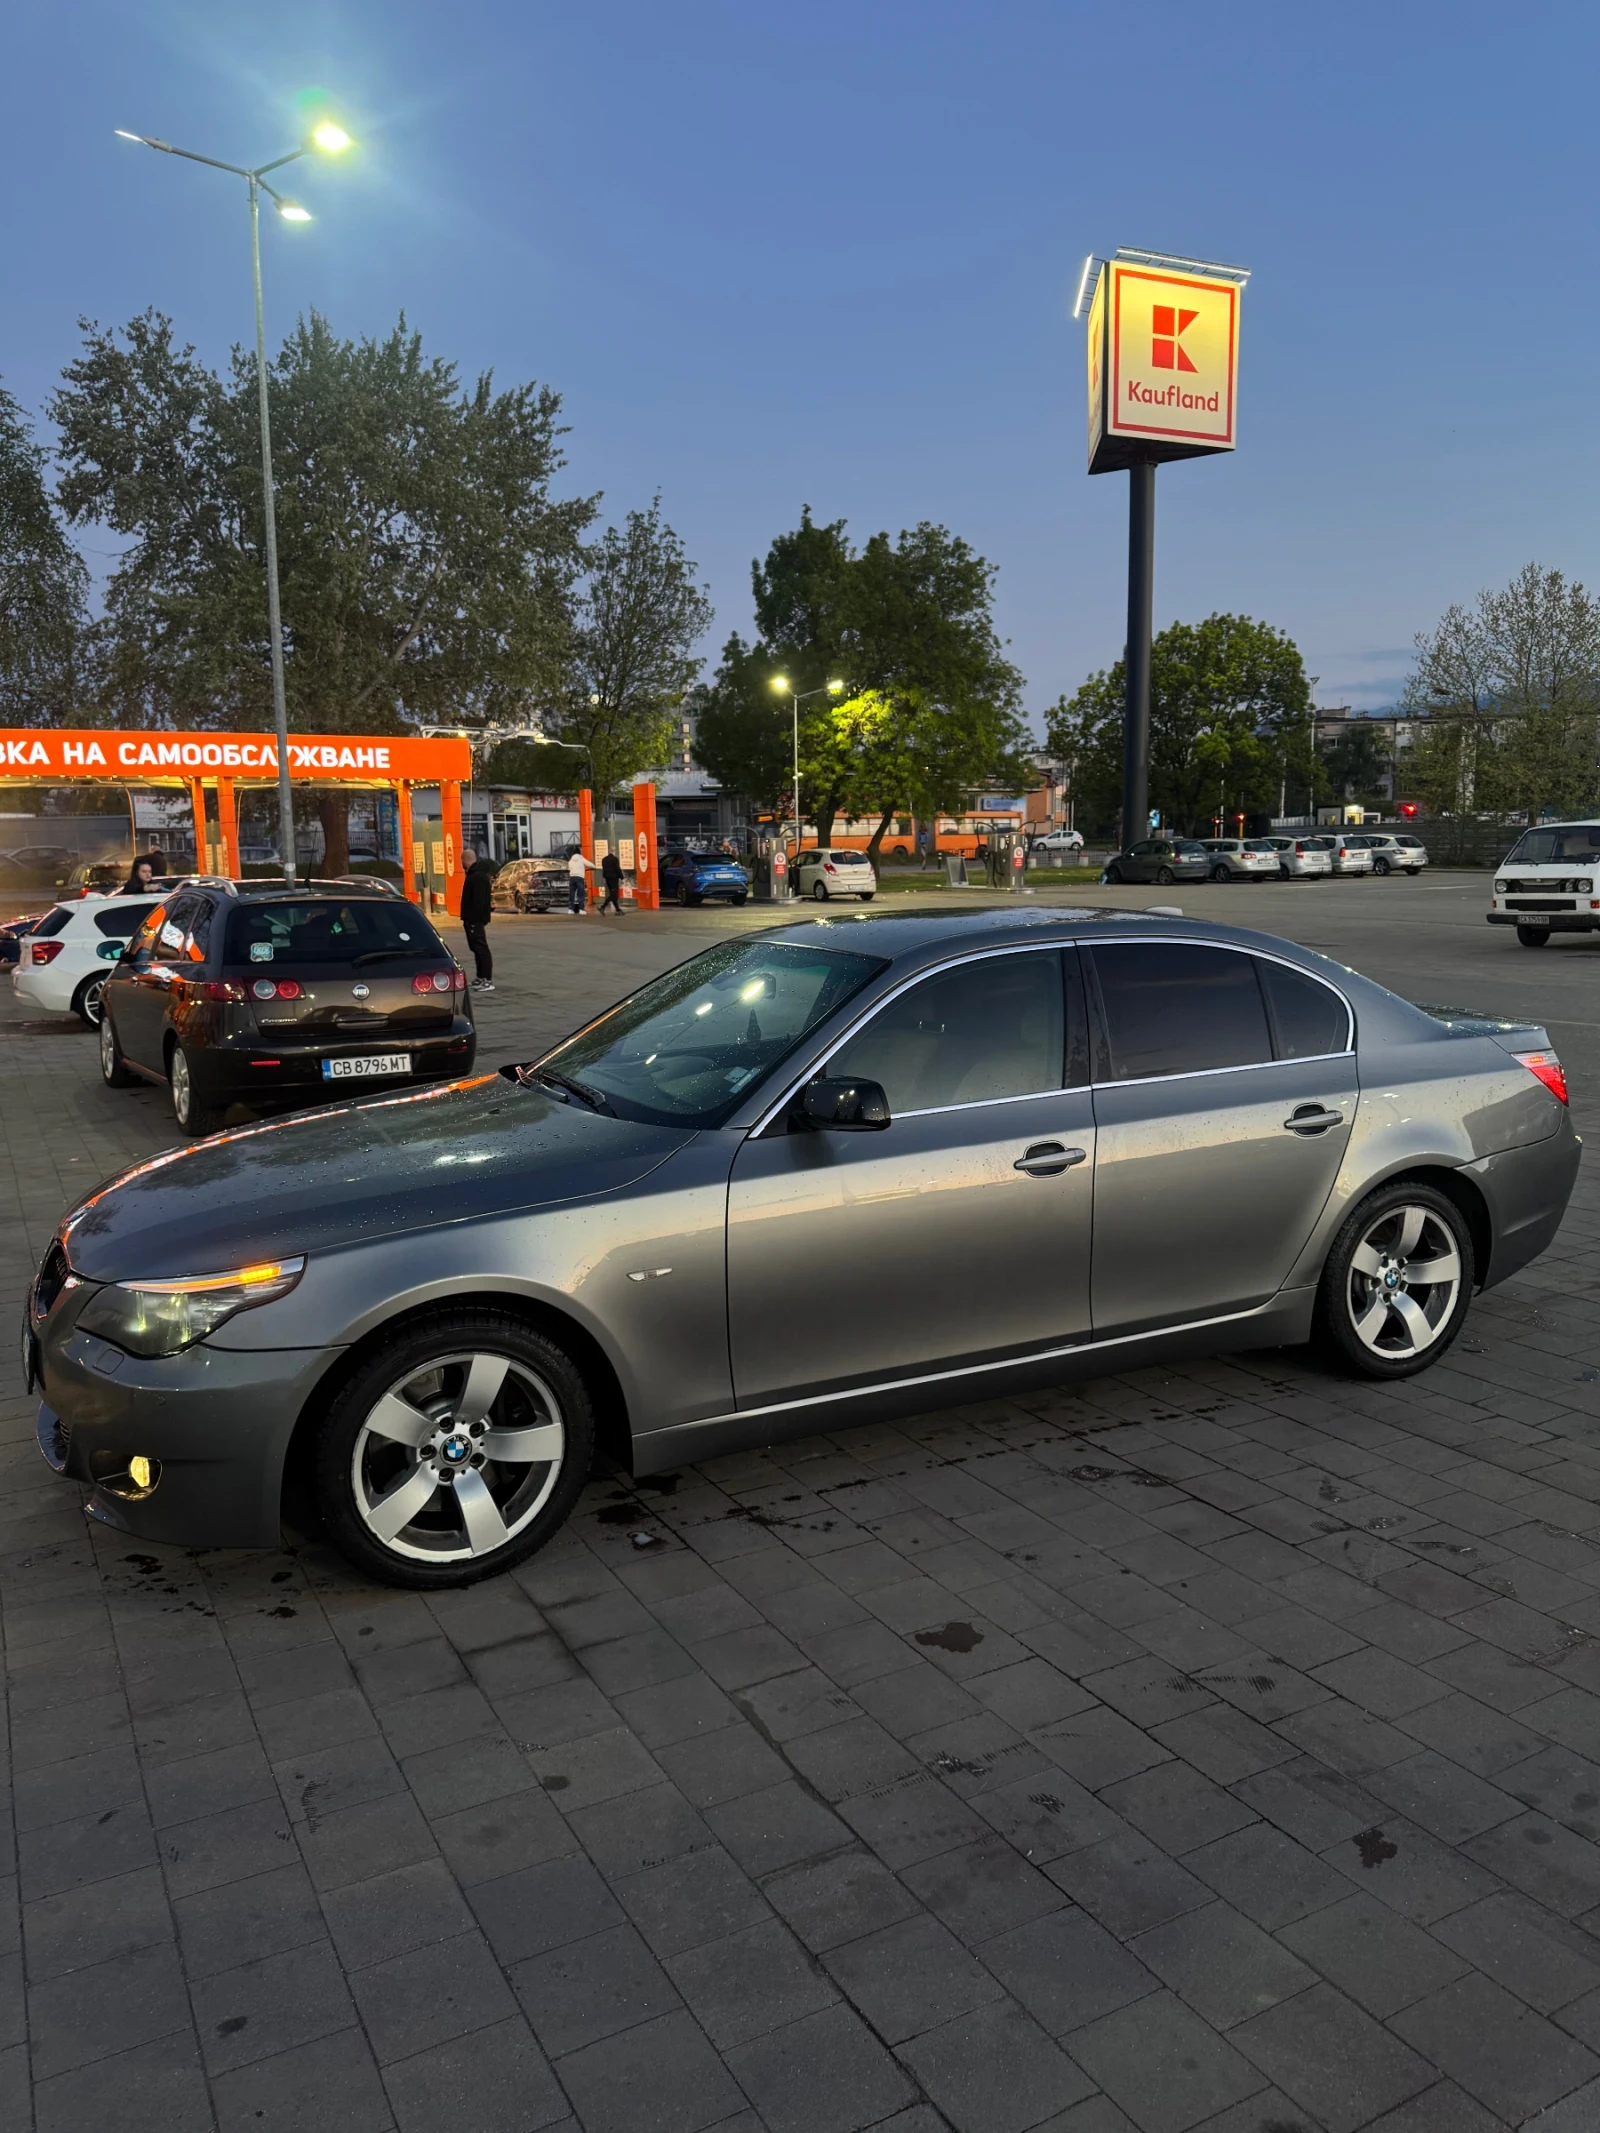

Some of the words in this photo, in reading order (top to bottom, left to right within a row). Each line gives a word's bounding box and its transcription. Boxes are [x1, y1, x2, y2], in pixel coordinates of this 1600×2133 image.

[1128, 380, 1219, 412] Kaufland
[62, 742, 107, 765] НА
[332, 1061, 352, 1076] CB
[354, 1058, 388, 1074] 8796
[390, 1056, 407, 1071] MT
